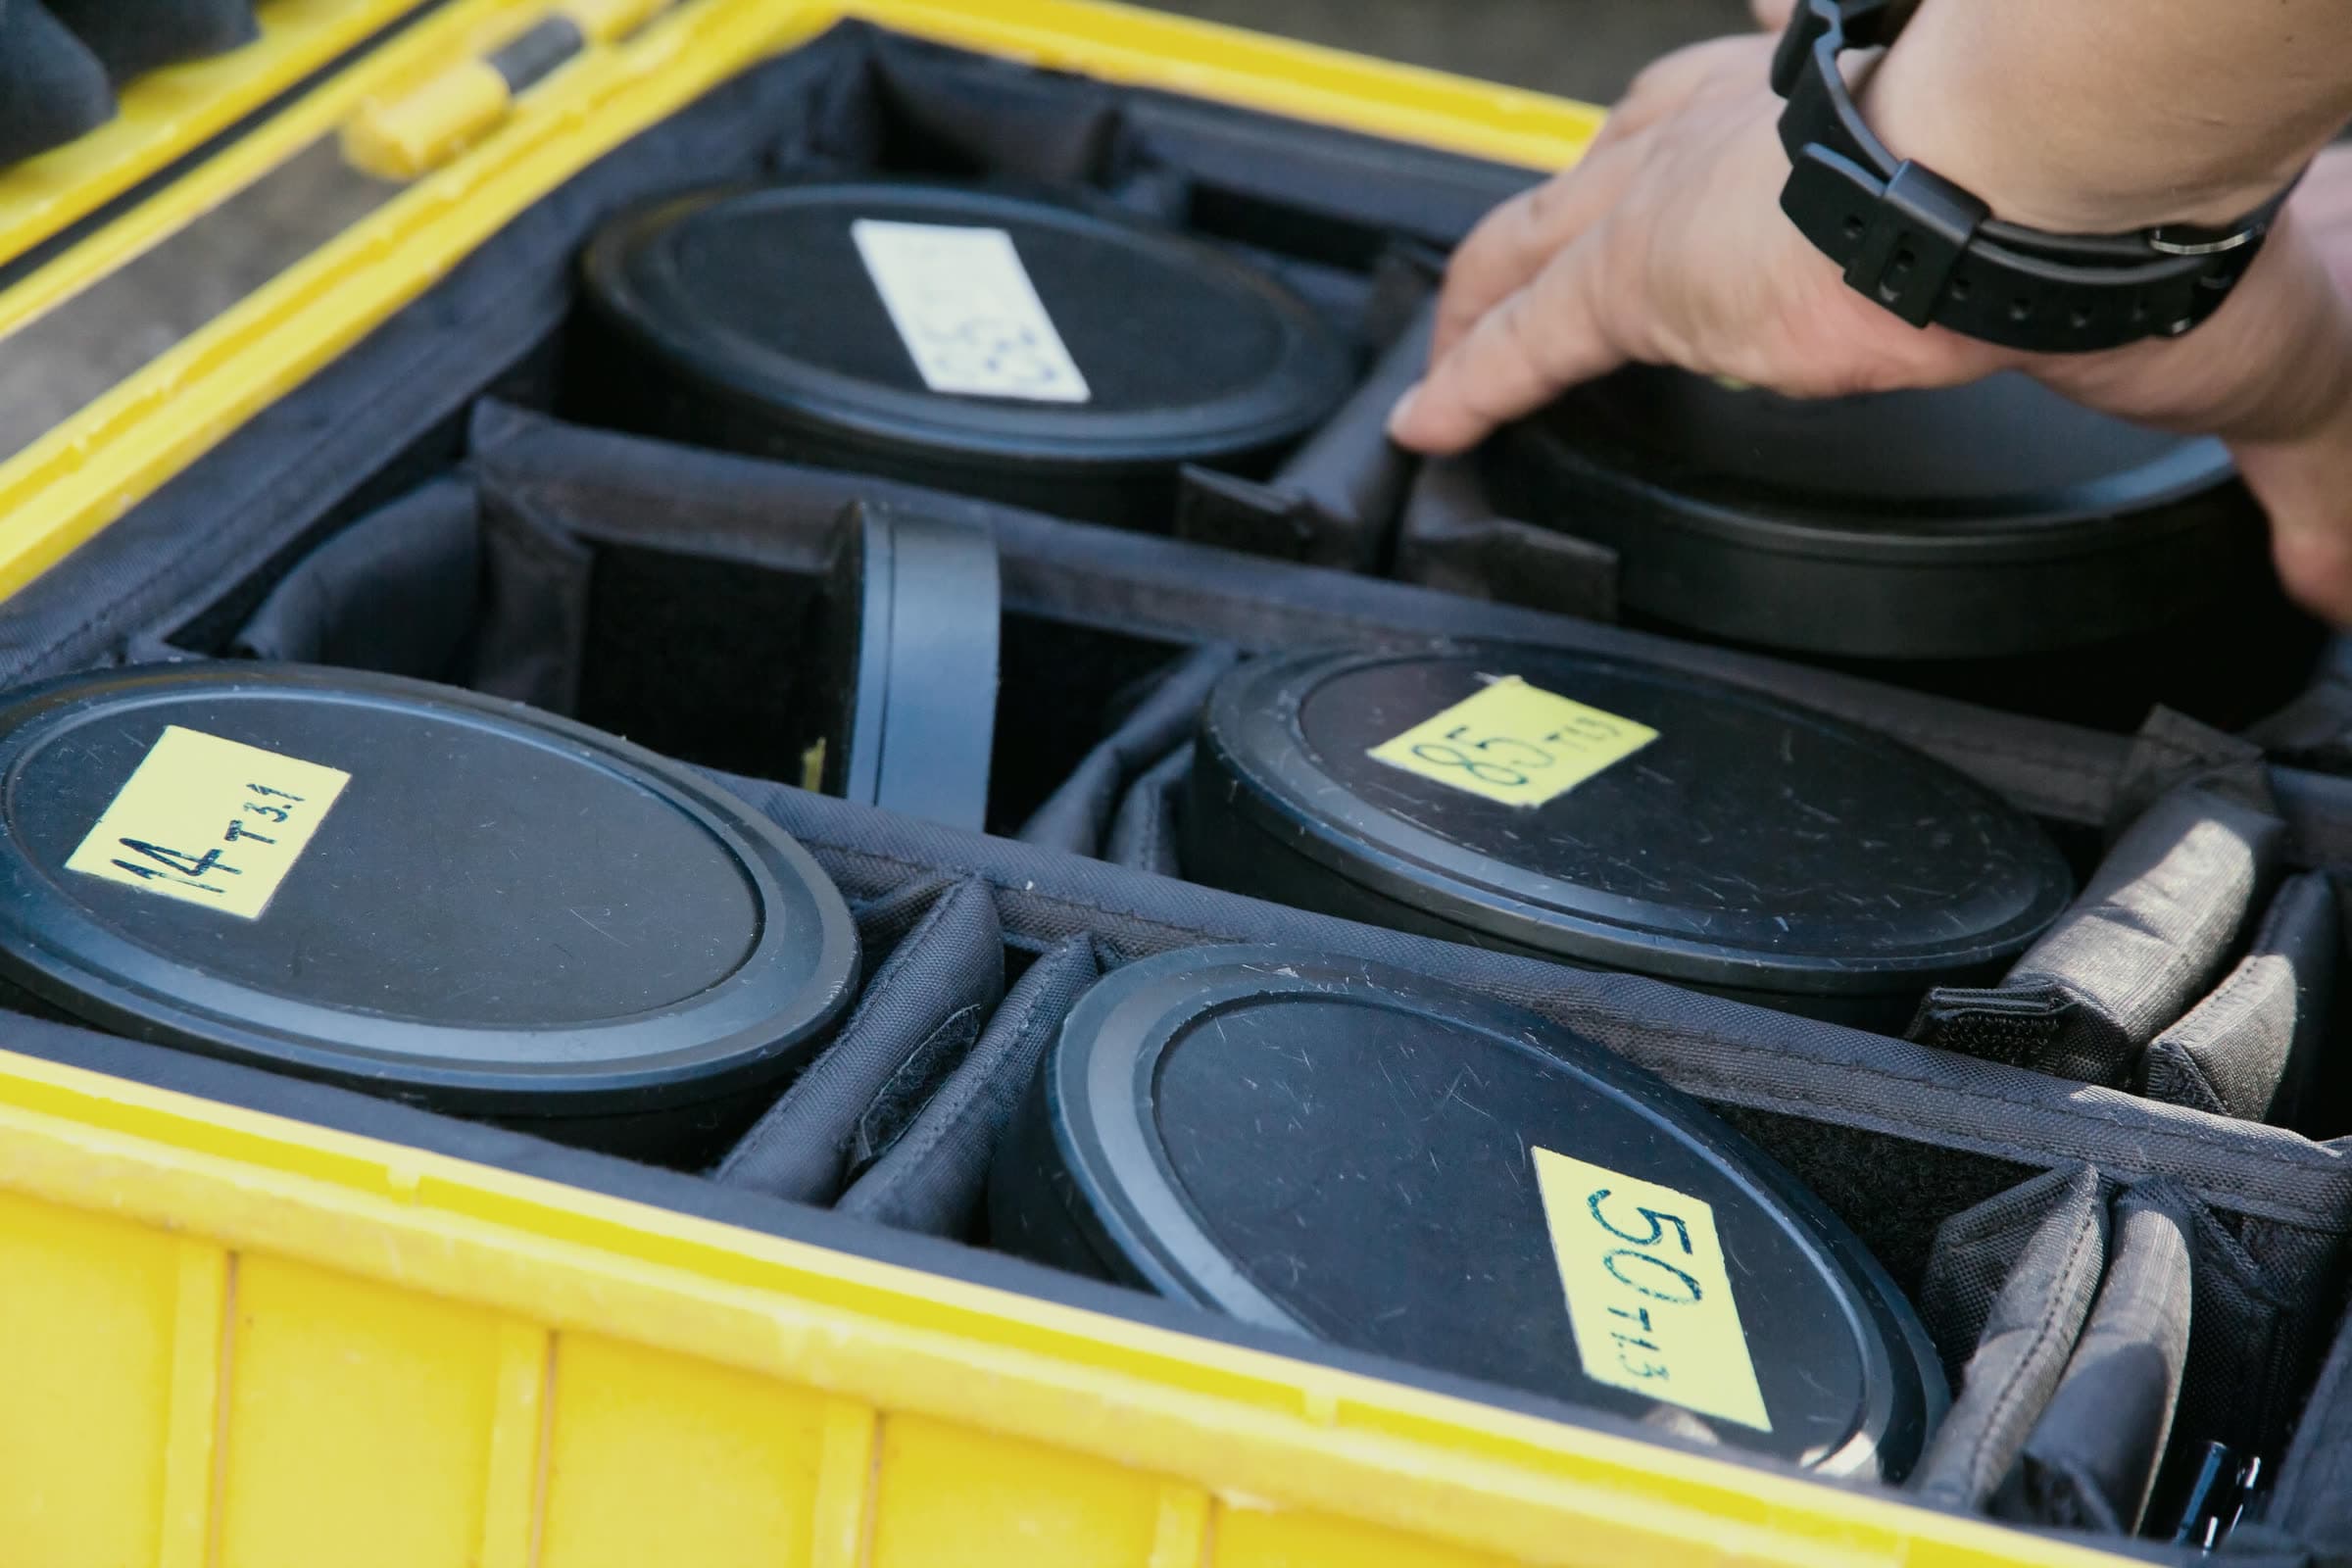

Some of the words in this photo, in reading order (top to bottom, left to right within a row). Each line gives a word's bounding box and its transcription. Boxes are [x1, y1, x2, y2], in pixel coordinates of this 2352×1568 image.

[1412, 724, 1555, 786] 85
[110, 837, 242, 894] 14
[1587, 1189, 1703, 1304] 50
